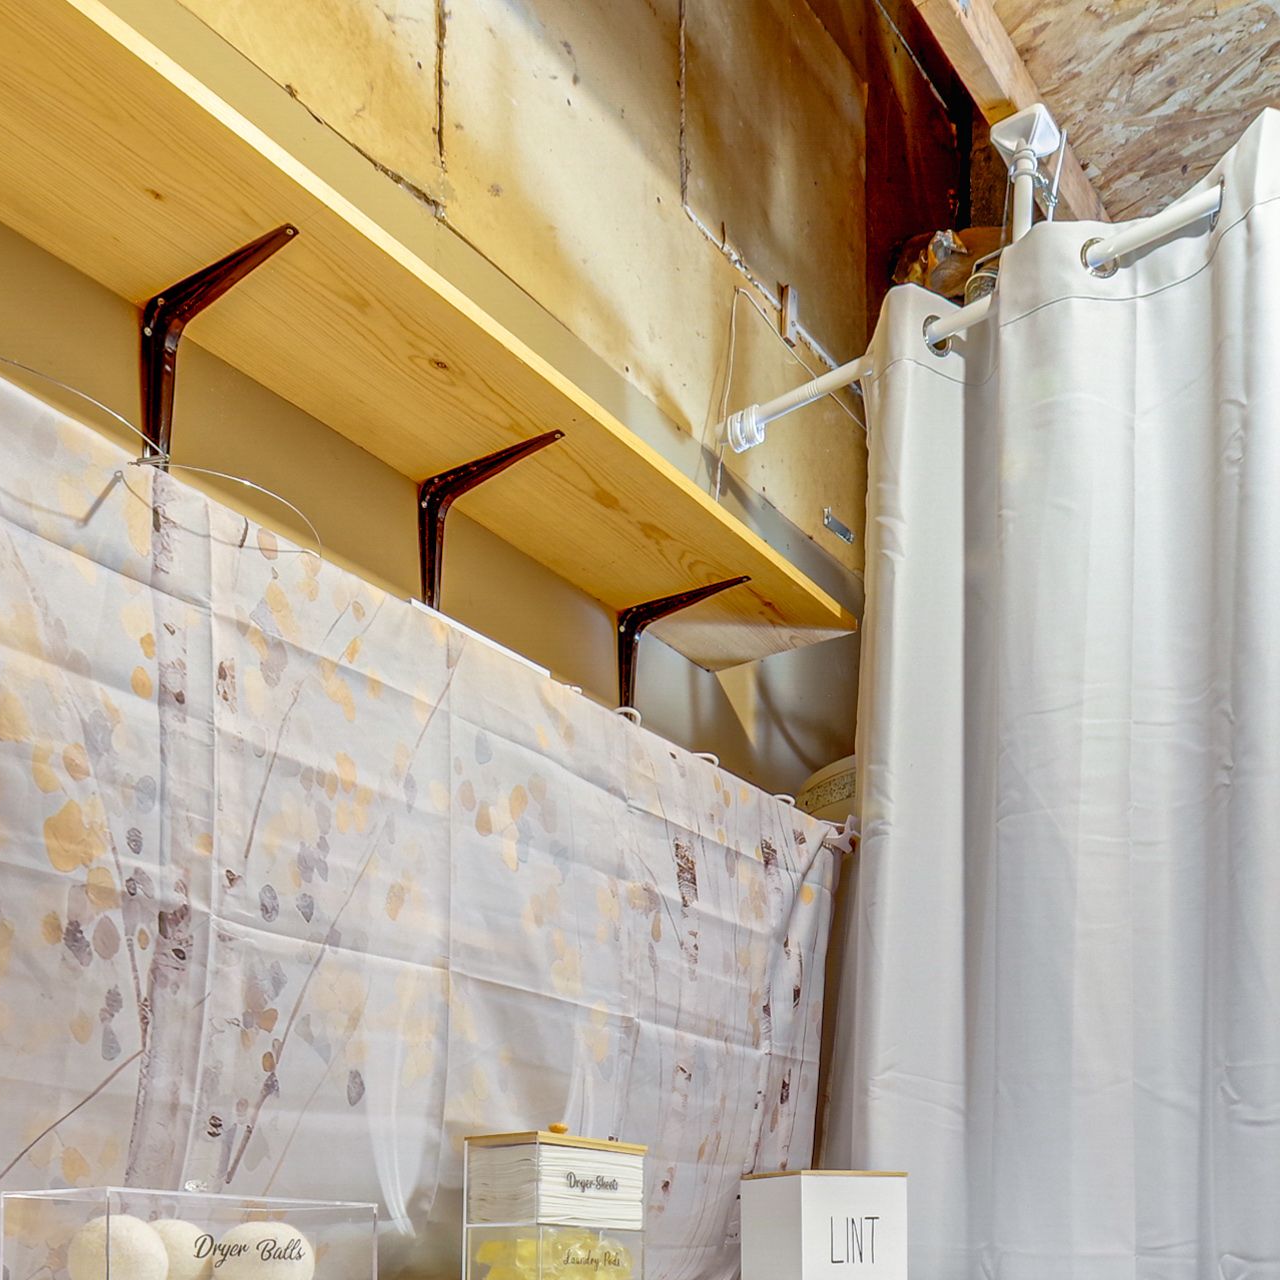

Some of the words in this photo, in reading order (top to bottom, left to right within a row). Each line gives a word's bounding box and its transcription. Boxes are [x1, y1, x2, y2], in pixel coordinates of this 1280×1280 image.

[567, 1171, 594, 1193] Dryer
[595, 1175, 618, 1191] Sheets
[193, 1234, 249, 1268] Dryer
[256, 1238, 305, 1261] Balls
[830, 1216, 880, 1264] LINT
[563, 1248, 600, 1272] Laundry
[603, 1251, 620, 1267] Pods
